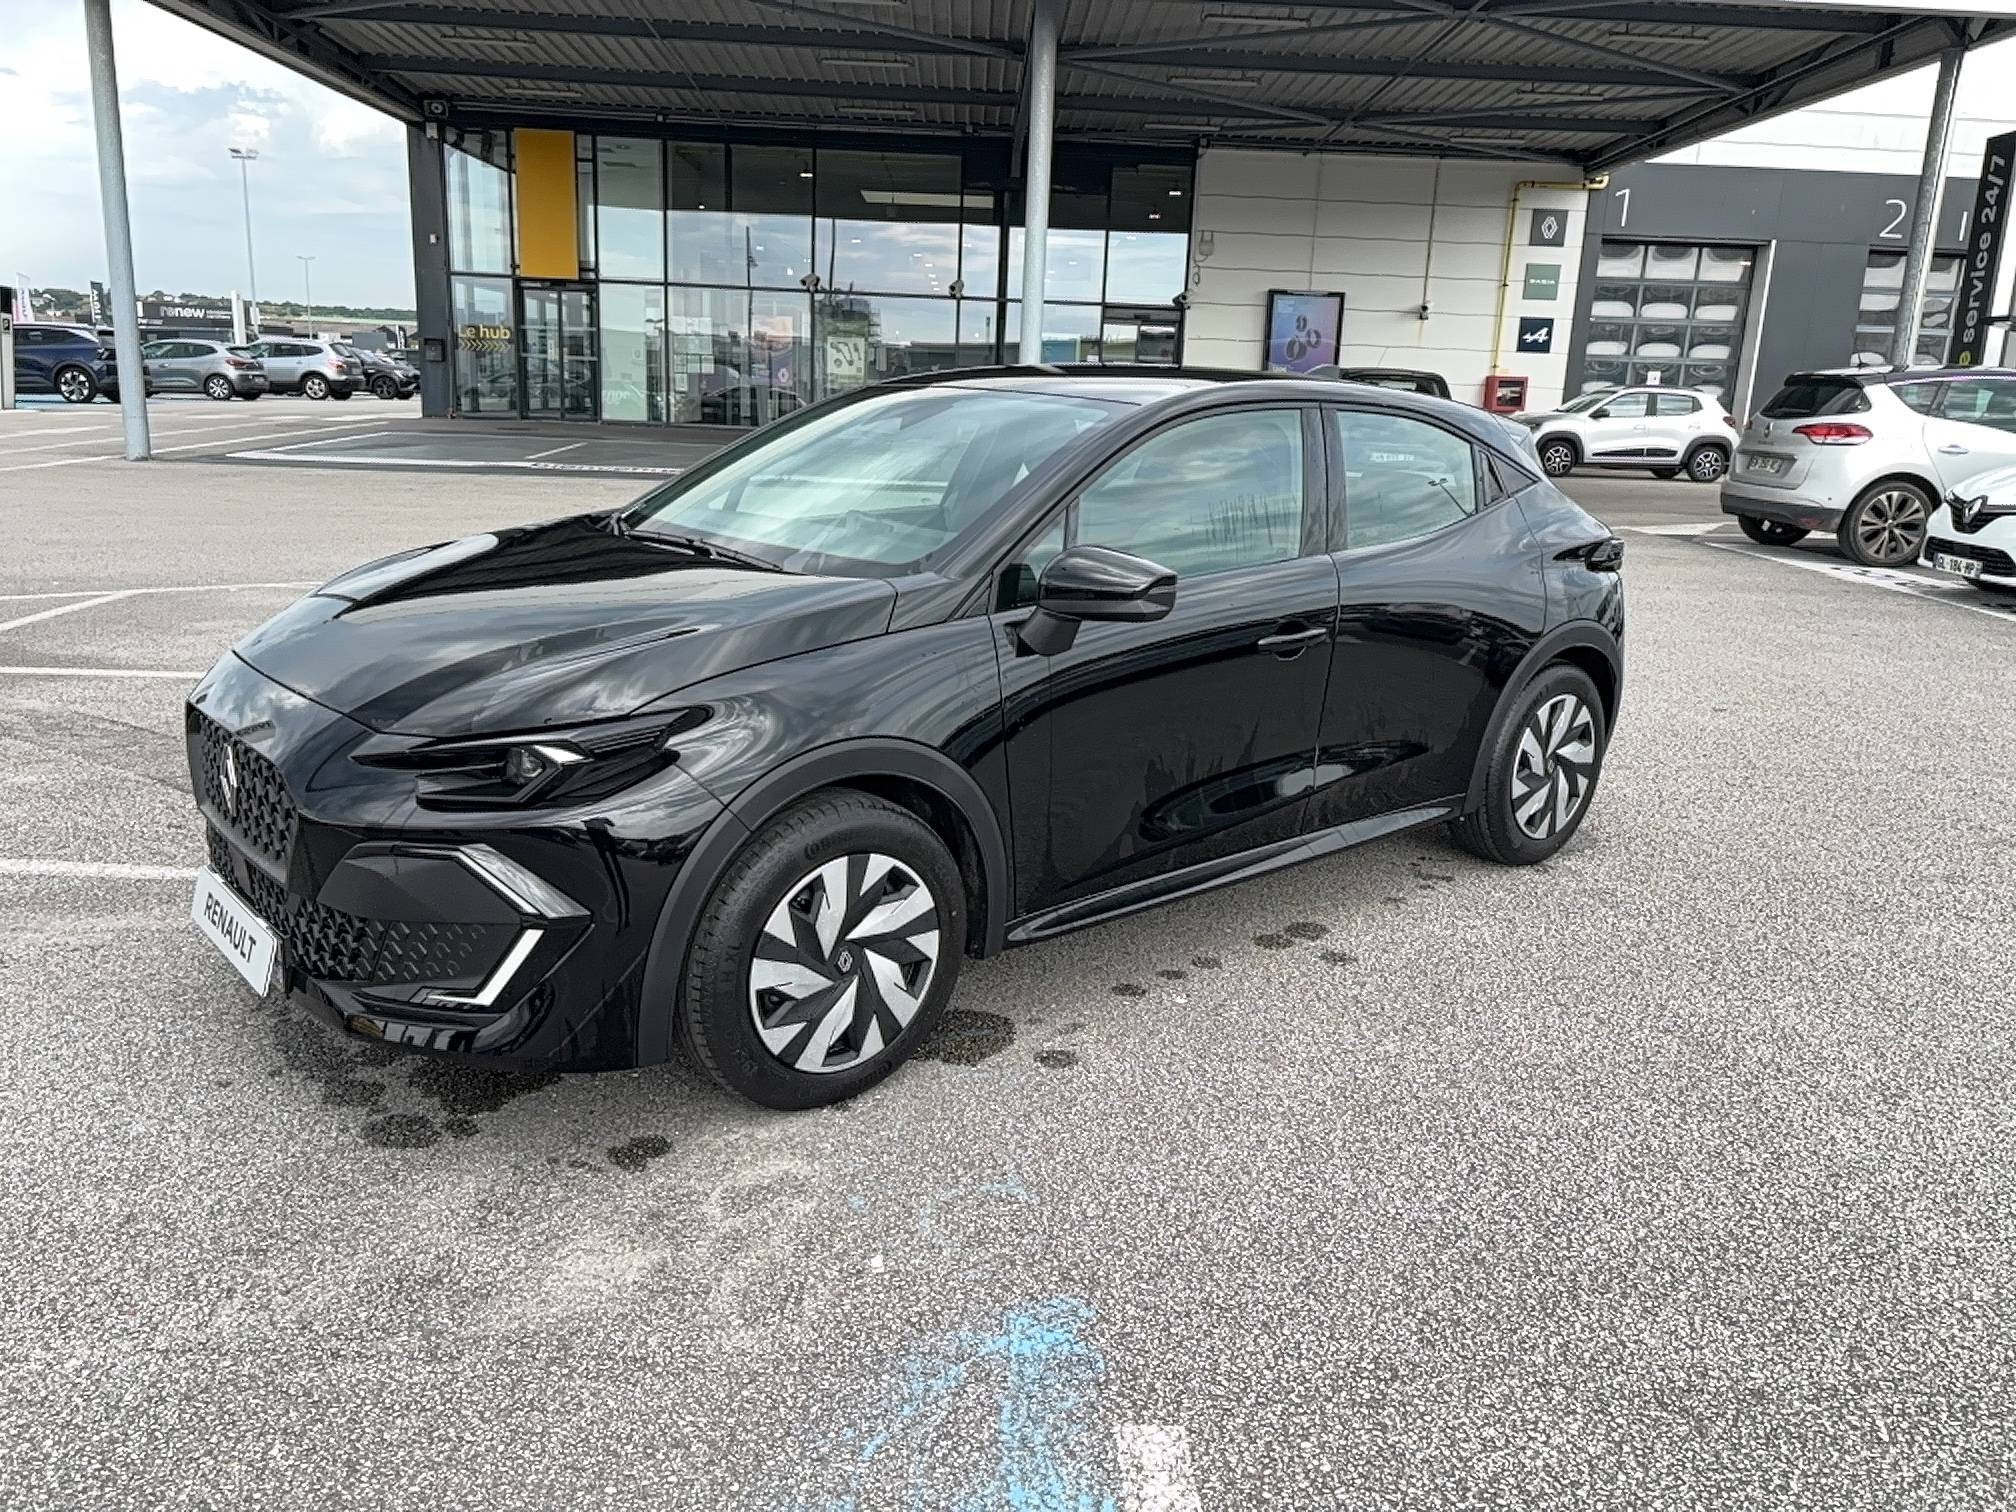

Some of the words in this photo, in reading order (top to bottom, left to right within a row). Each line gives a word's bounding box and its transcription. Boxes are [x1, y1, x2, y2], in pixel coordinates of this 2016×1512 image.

[1615, 188, 1631, 227] 1
[1879, 199, 1907, 239] 2
[1963, 231, 1991, 343] service
[1981, 154, 2006, 225] 24/7
[457, 324, 476, 338] Le
[479, 324, 511, 339] hub
[203, 891, 257, 963] RENAULT
